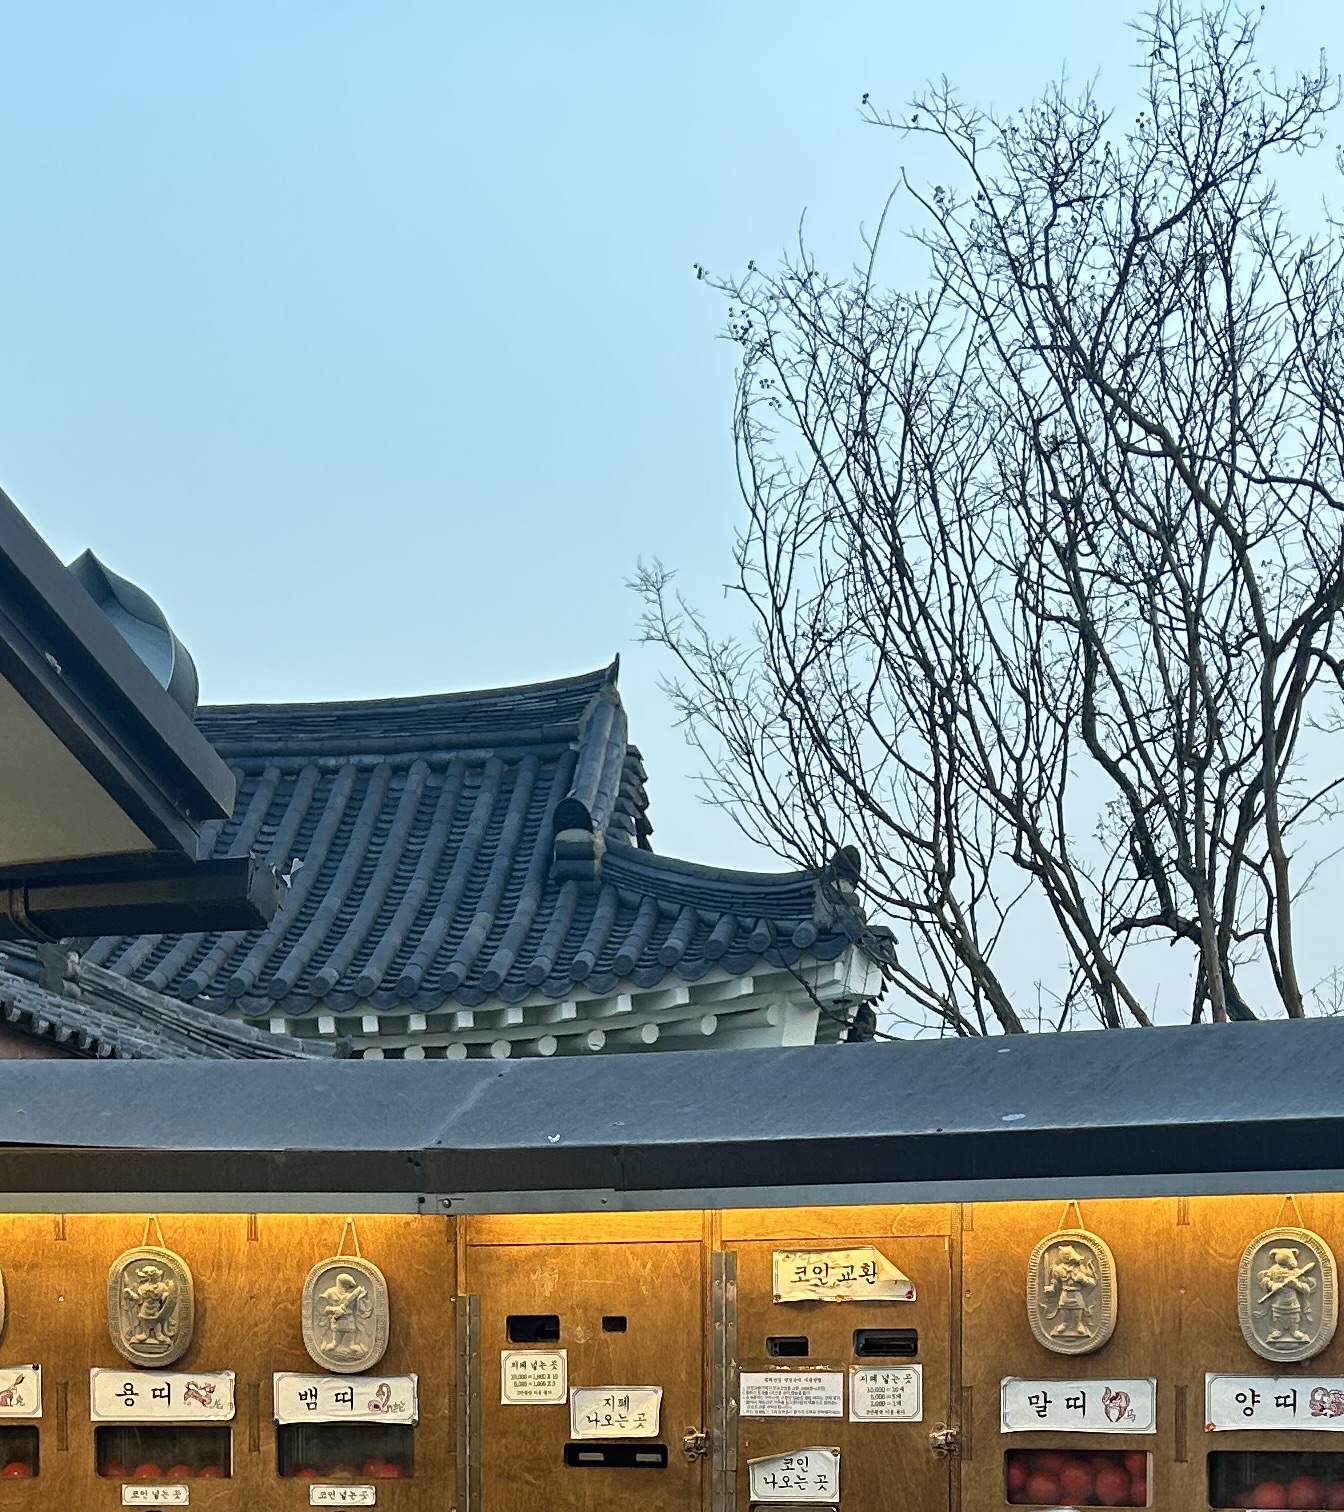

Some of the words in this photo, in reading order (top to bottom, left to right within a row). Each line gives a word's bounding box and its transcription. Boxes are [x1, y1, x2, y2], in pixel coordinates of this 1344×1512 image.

[789, 1263, 829, 1285] 코인
[836, 1261, 878, 1285] 교환
[530, 1359, 547, 1371] 넣는
[550, 1360, 558, 1371] 곳
[860, 1374, 877, 1384] 지폐
[881, 1374, 900, 1384] 넣는
[903, 1374, 912, 1384] 곳
[115, 1382, 139, 1407] 용
[152, 1381, 171, 1408] 띠
[298, 1386, 318, 1412] 뱀
[334, 1386, 354, 1412] 띠
[602, 1394, 630, 1413] 지폐
[1235, 1388, 1260, 1417] 양
[1274, 1388, 1297, 1418] 띠
[1027, 1390, 1052, 1418] 말
[1065, 1390, 1086, 1420] 띠
[586, 1411, 629, 1430] 나오는
[633, 1412, 647, 1430] 곳
[780, 1456, 809, 1473] 코인
[763, 1473, 808, 1491] 나오는
[813, 1474, 829, 1492] 곳
[131, 1489, 148, 1499] 코인
[152, 1489, 170, 1500] 넣는
[172, 1489, 182, 1499] 곳
[318, 1490, 336, 1500] 코인
[339, 1490, 357, 1500] 넣는
[360, 1490, 370, 1500] 곳
